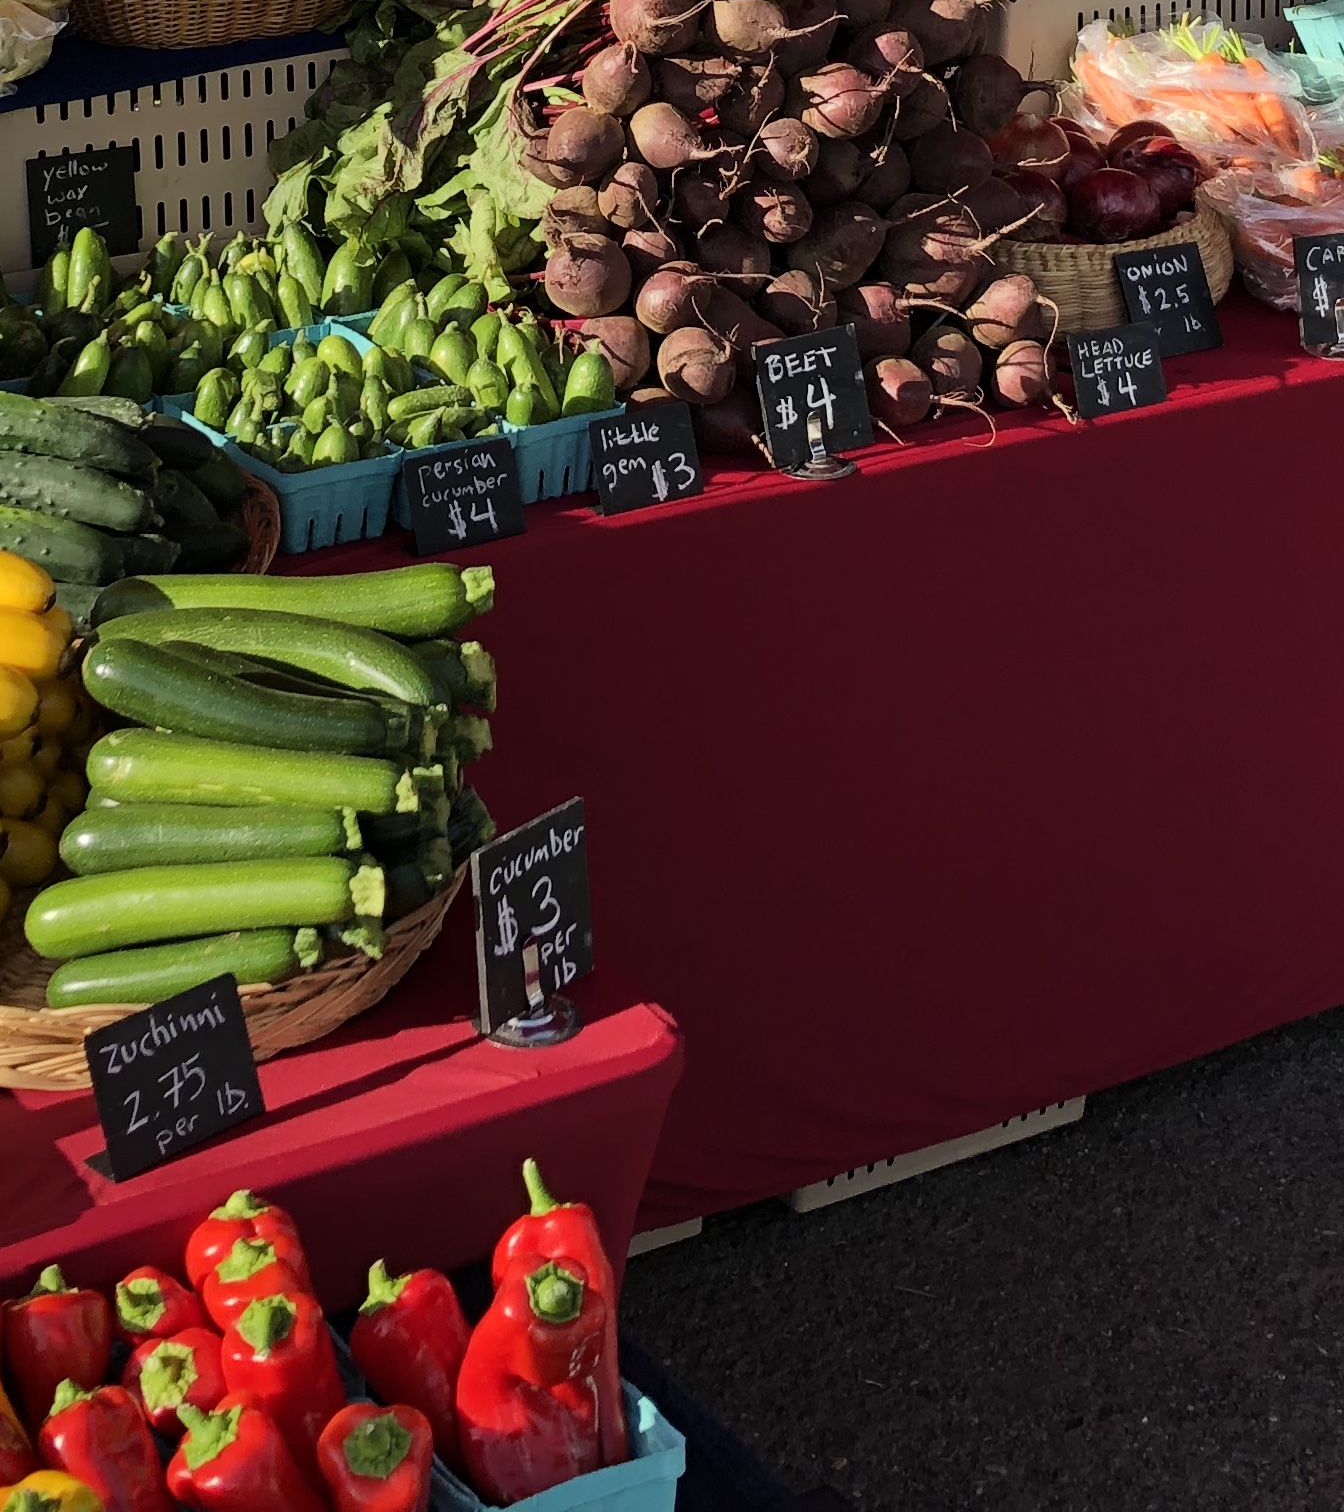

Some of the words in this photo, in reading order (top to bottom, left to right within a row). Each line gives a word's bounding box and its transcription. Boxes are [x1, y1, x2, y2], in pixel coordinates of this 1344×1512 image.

[47, 185, 88, 205] wax
[45, 206, 101, 226] bean
[1078, 337, 1124, 360] HEAD
[1081, 349, 1153, 378] LETTUCE
[764, 346, 837, 384] BEET
[600, 421, 660, 452] little
[603, 455, 647, 493] gem
[123, 1051, 206, 1135] 2.75
